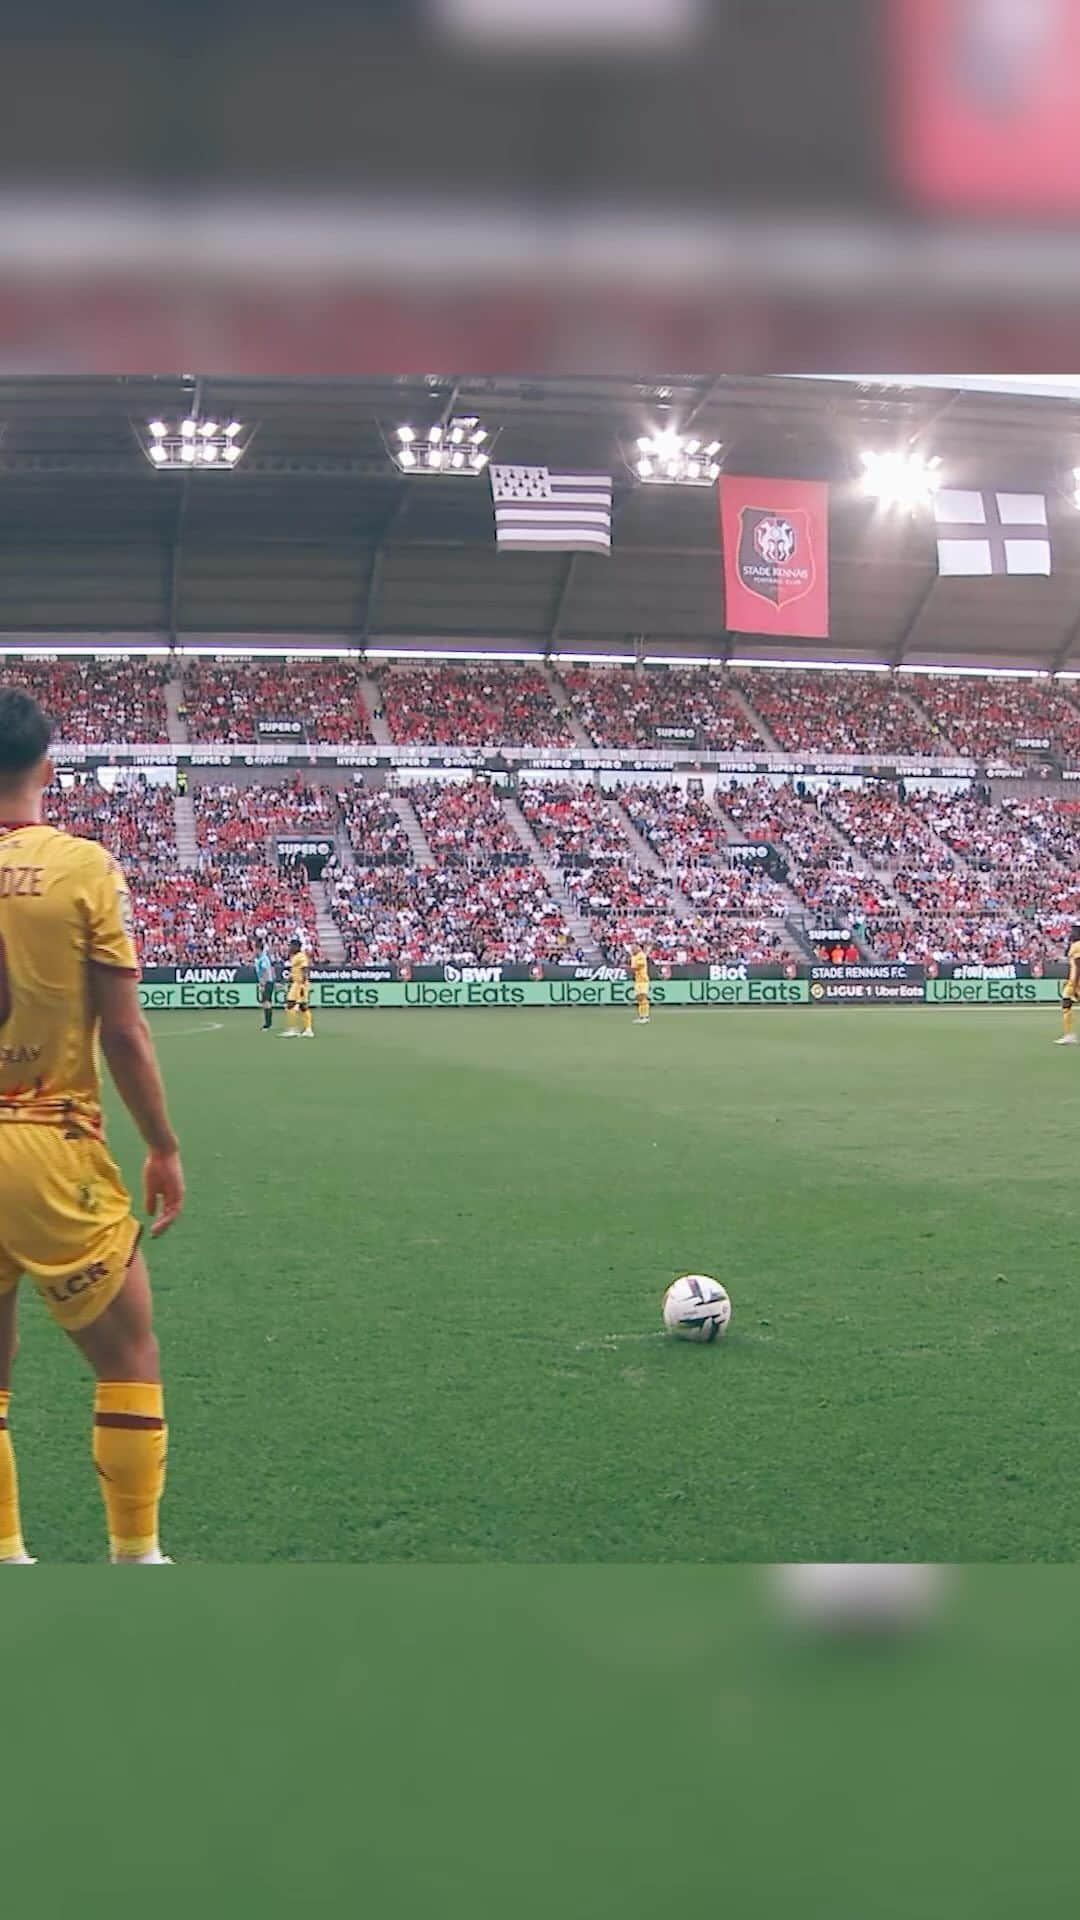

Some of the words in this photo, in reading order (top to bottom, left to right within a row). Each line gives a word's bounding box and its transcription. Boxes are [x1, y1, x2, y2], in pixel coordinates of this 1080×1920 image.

[743, 566, 770, 577] STADE
[259, 722, 291, 732] SUPER
[656, 728, 686, 737] SUPER
[1015, 739, 1041, 748] SUPER
[190, 756, 221, 766] SUPER
[336, 757, 368, 766] HYPER
[390, 757, 420, 766] SUPER
[533, 759, 563, 768] HYPER
[584, 760, 612, 769] SUPER
[278, 843, 318, 855] SUPER
[808, 930, 841, 940] SUPER
[175, 968, 237, 982] LAUNAY
[461, 966, 503, 982] BWT
[811, 967, 845, 979] STADE
[845, 967, 890, 979] RENNAIS
[181, 985, 240, 1006] Eats
[320, 984, 379, 1004] Eats
[404, 983, 462, 1004] Uber
[467, 984, 525, 1003] Eats
[549, 983, 605, 1002] Uber
[689, 982, 743, 1001] Uber
[748, 982, 801, 1001] Eats
[826, 985, 864, 997] LIGUE
[865, 985, 872, 996] 1
[875, 985, 900, 997] Uber
[900, 985, 924, 997] Eats
[933, 980, 983, 1001] Uber
[987, 981, 1037, 1000] Eats
